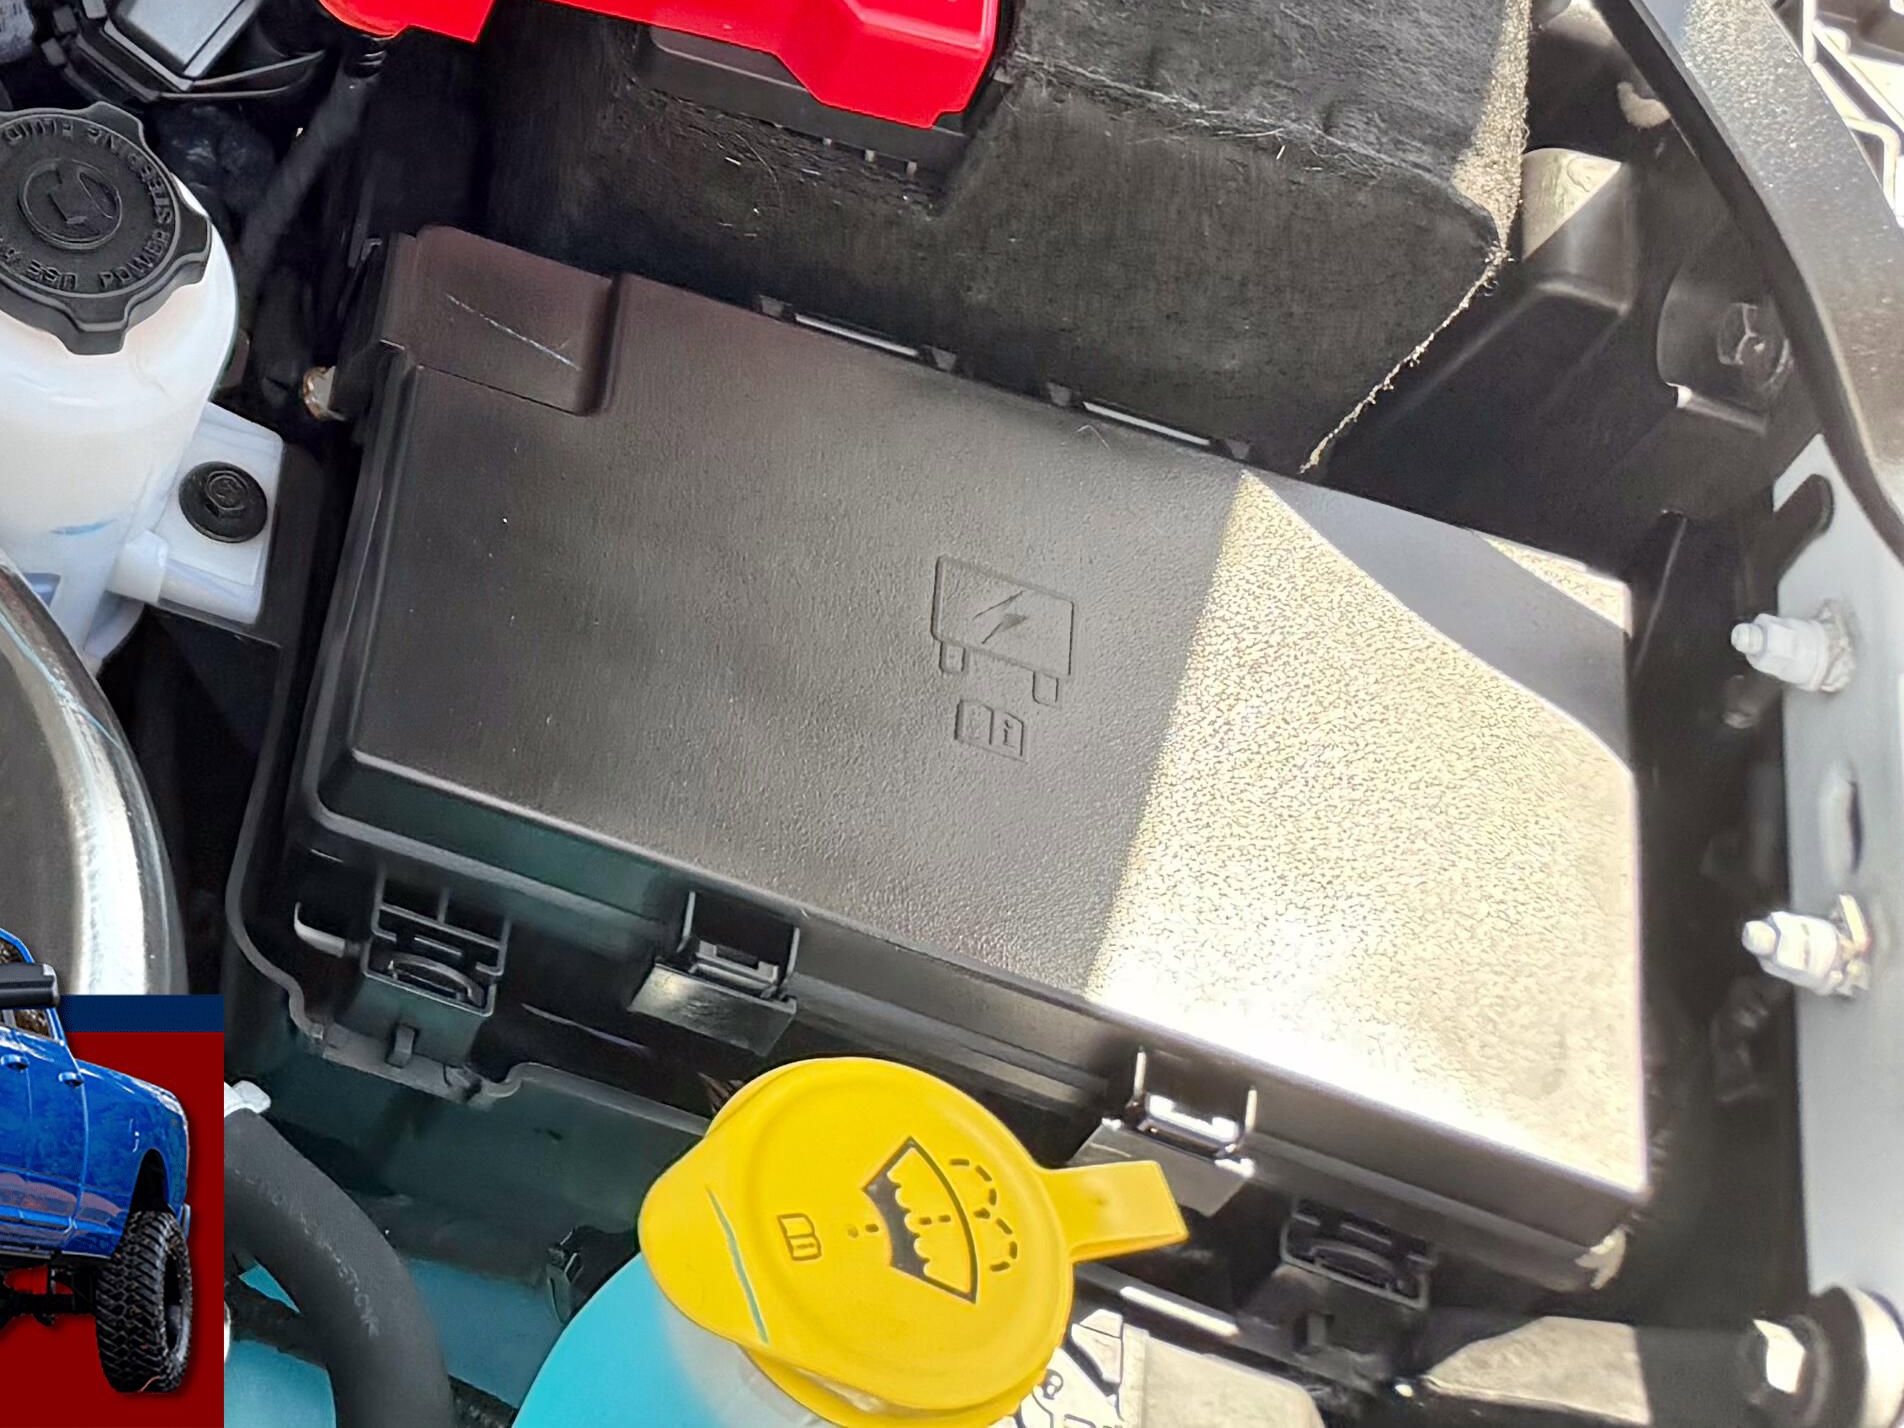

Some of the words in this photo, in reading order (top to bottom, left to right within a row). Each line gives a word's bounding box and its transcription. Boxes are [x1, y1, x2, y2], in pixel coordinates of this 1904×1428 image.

[0, 118, 74, 145] FLUID
[86, 126, 174, 226] STEERING
[25, 259, 78, 291] USE
[98, 227, 170, 291] POWER
